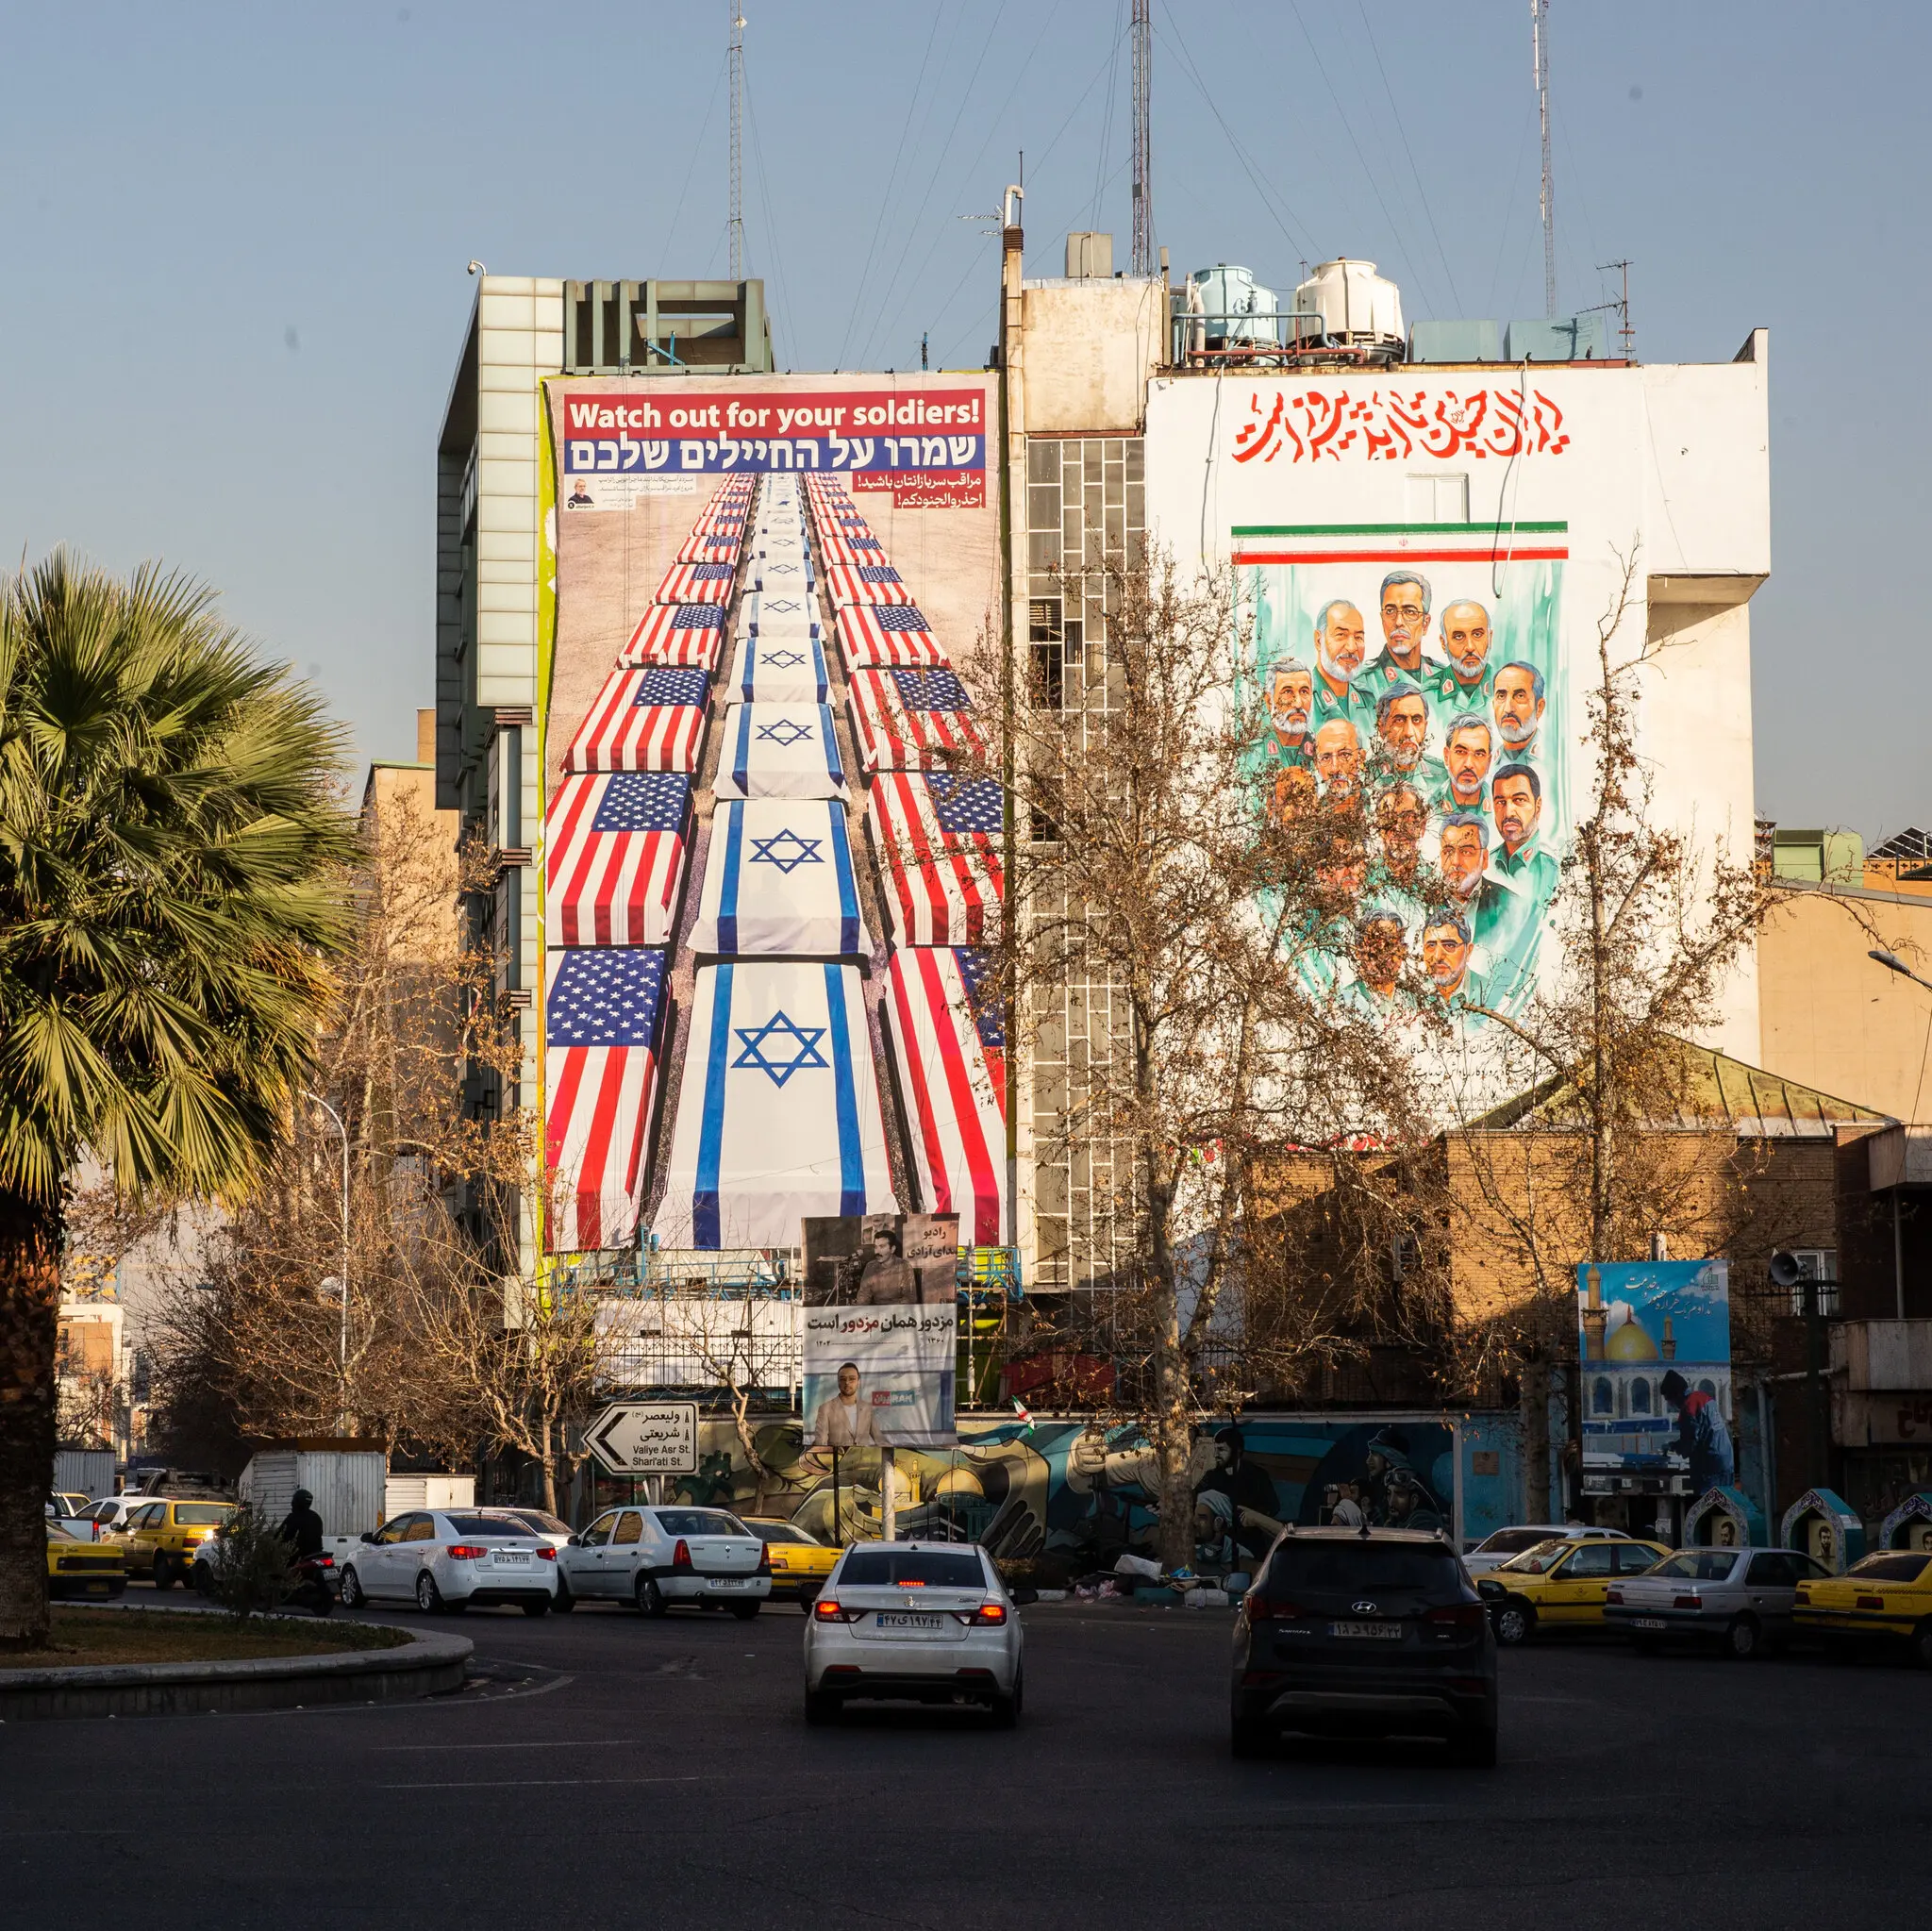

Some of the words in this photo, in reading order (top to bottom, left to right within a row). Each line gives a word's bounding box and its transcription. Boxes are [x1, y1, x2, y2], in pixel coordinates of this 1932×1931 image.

[569, 402, 661, 428] Watch
[669, 405, 721, 427] out
[725, 401, 771, 427] for
[776, 407, 846, 434] your
[853, 398, 980, 425] soldiers!
[570, 430, 670, 470] שלכם
[679, 430, 819, 470] החיילים
[828, 428, 875, 470] על
[884, 436, 977, 467] שמרו
[858, 474, 893, 489] باشید!
[893, 474, 947, 489] سربازانتان
[948, 473, 982, 489] مراقب
[922, 1226, 946, 1240] رادیو
[907, 1244, 933, 1258] آزادی
[807, 1312, 840, 1329] است
[840, 1316, 879, 1333] مزدور
[880, 1313, 918, 1333] همان
[918, 1315, 954, 1332] مزدور
[640, 1427, 680, 1441] شریعتی
[633, 1445, 658, 1456] Valiye
[661, 1445, 676, 1454] Asr
[678, 1444, 691, 1454] St.
[670, 1457, 683, 1466] St.
